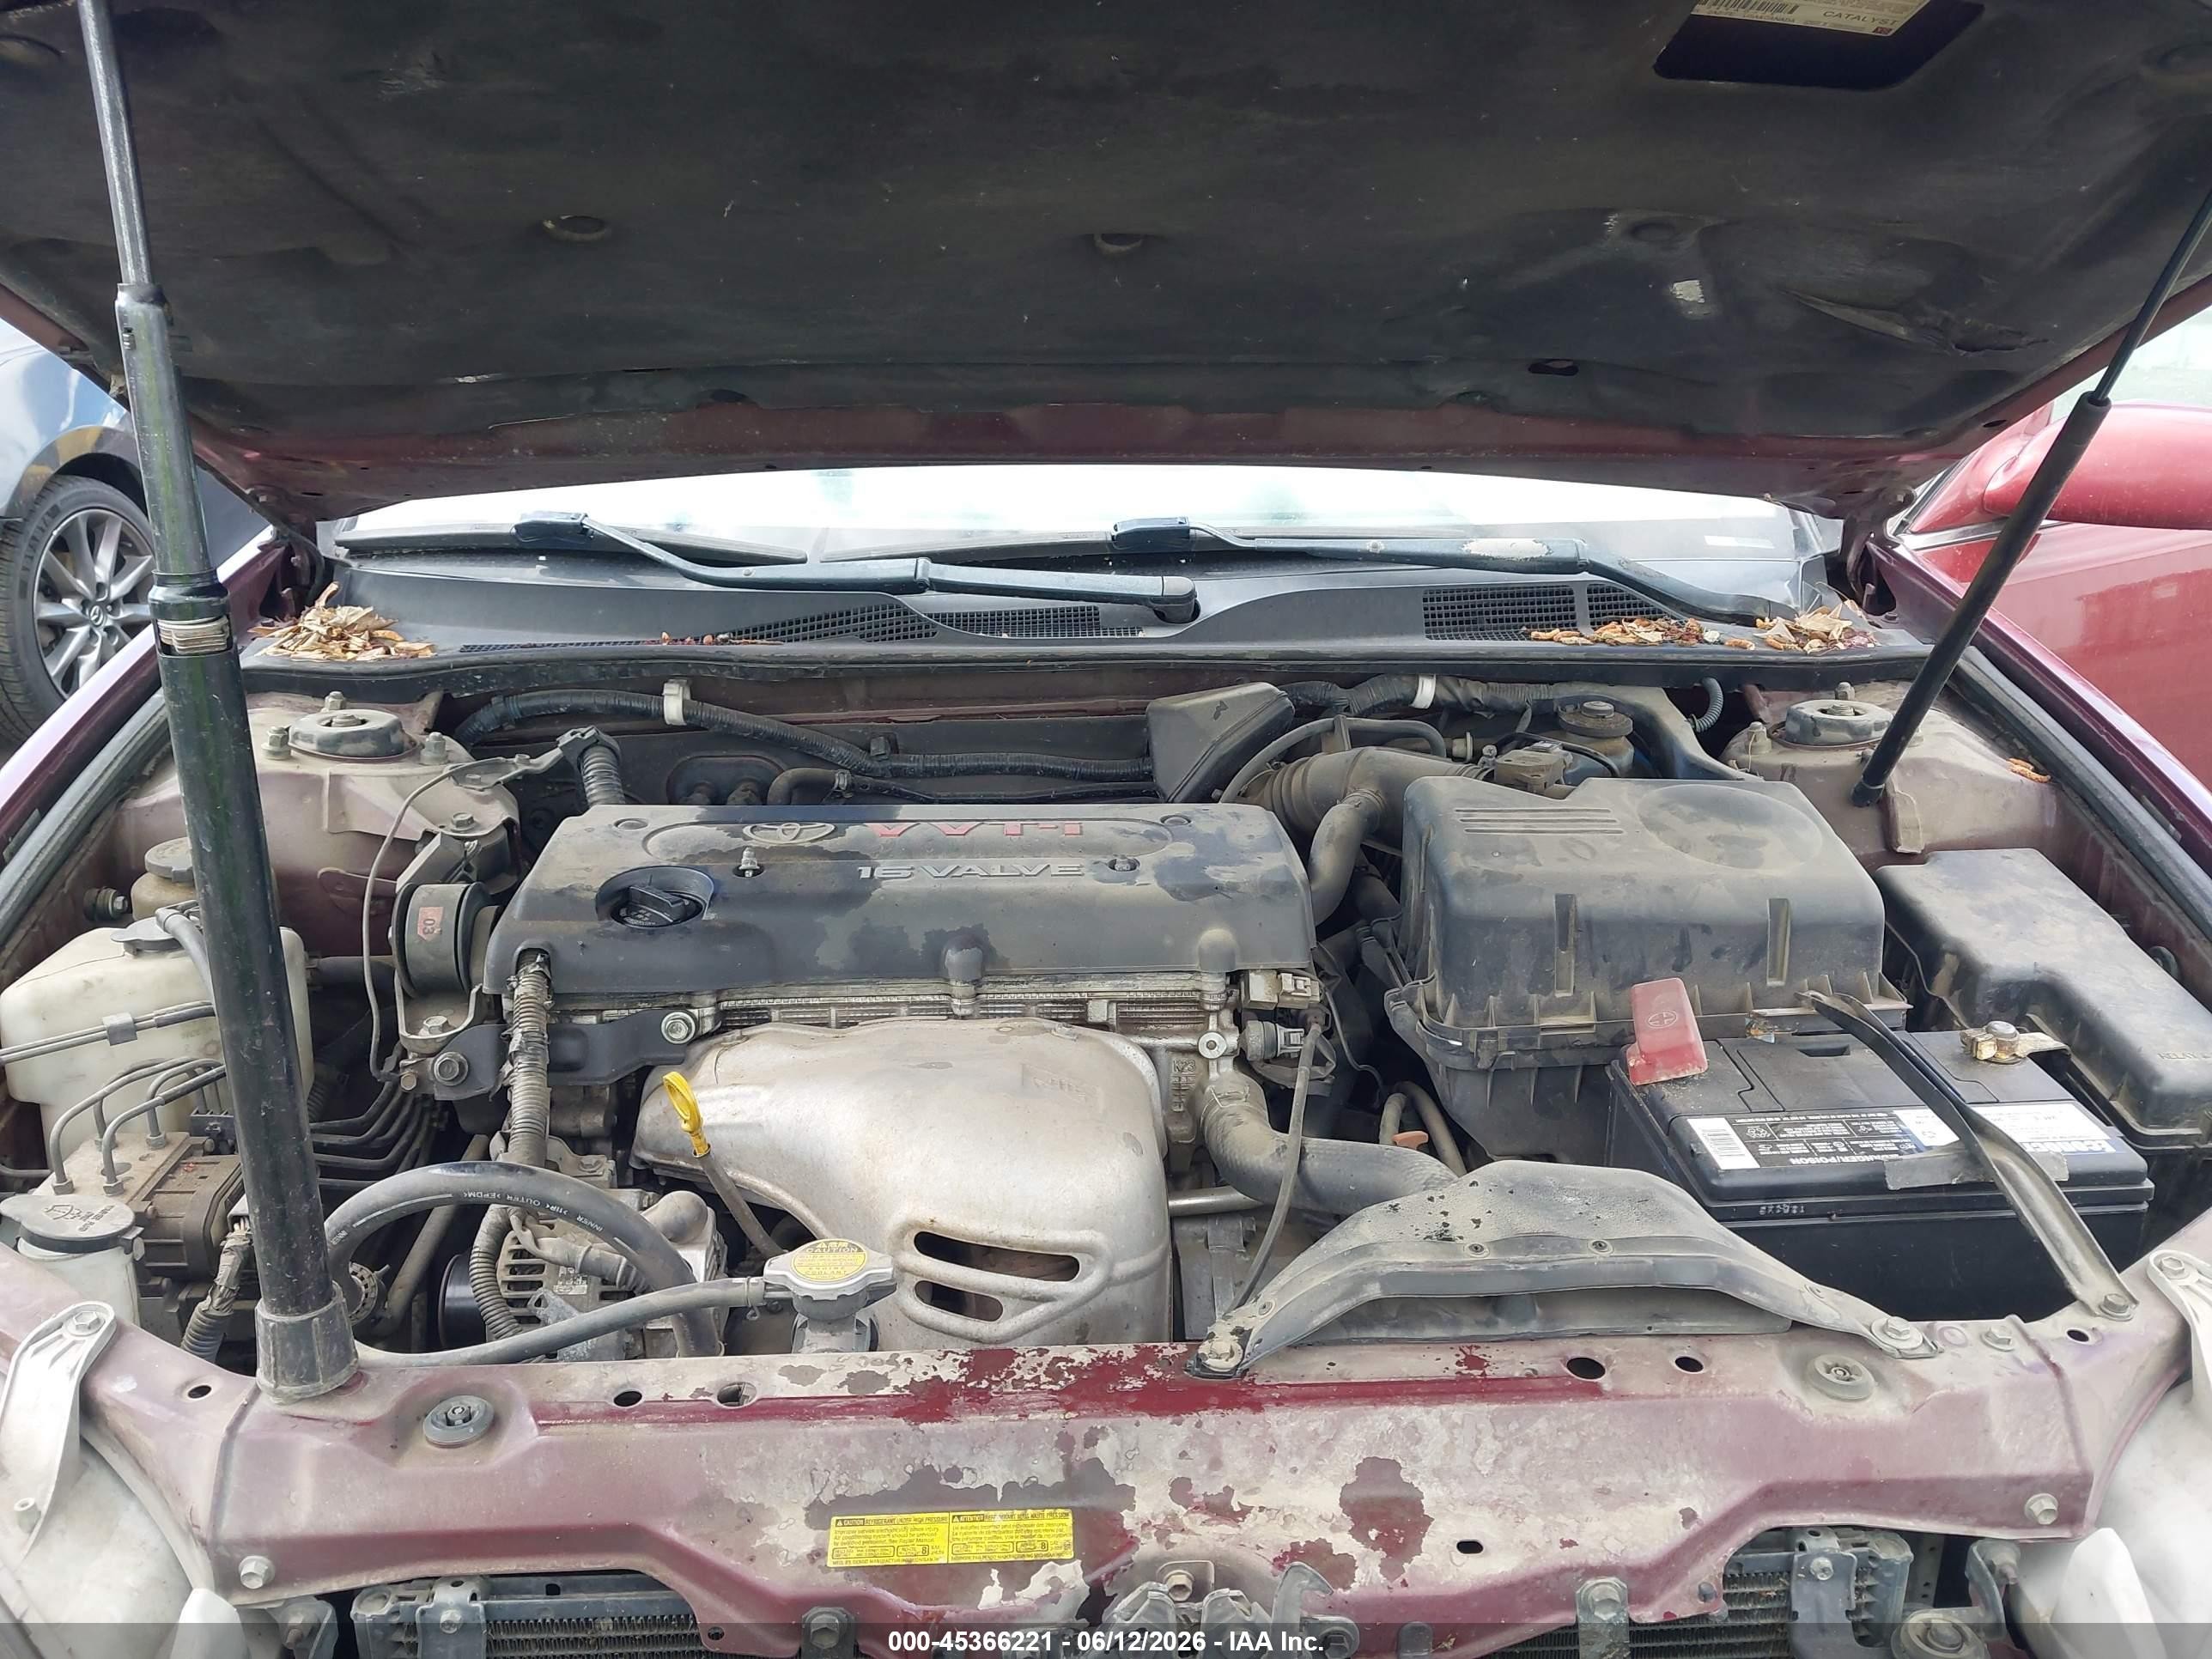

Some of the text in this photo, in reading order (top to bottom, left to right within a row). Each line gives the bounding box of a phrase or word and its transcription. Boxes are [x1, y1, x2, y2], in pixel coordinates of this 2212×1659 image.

[1823, 11, 1900, 27] CATALYST
[859, 865, 1084, 879] 16 VALVE
[507, 1194, 541, 1206] OUTER
[576, 1214, 604, 1232] INNER
[921, 1546, 927, 1555] 8
